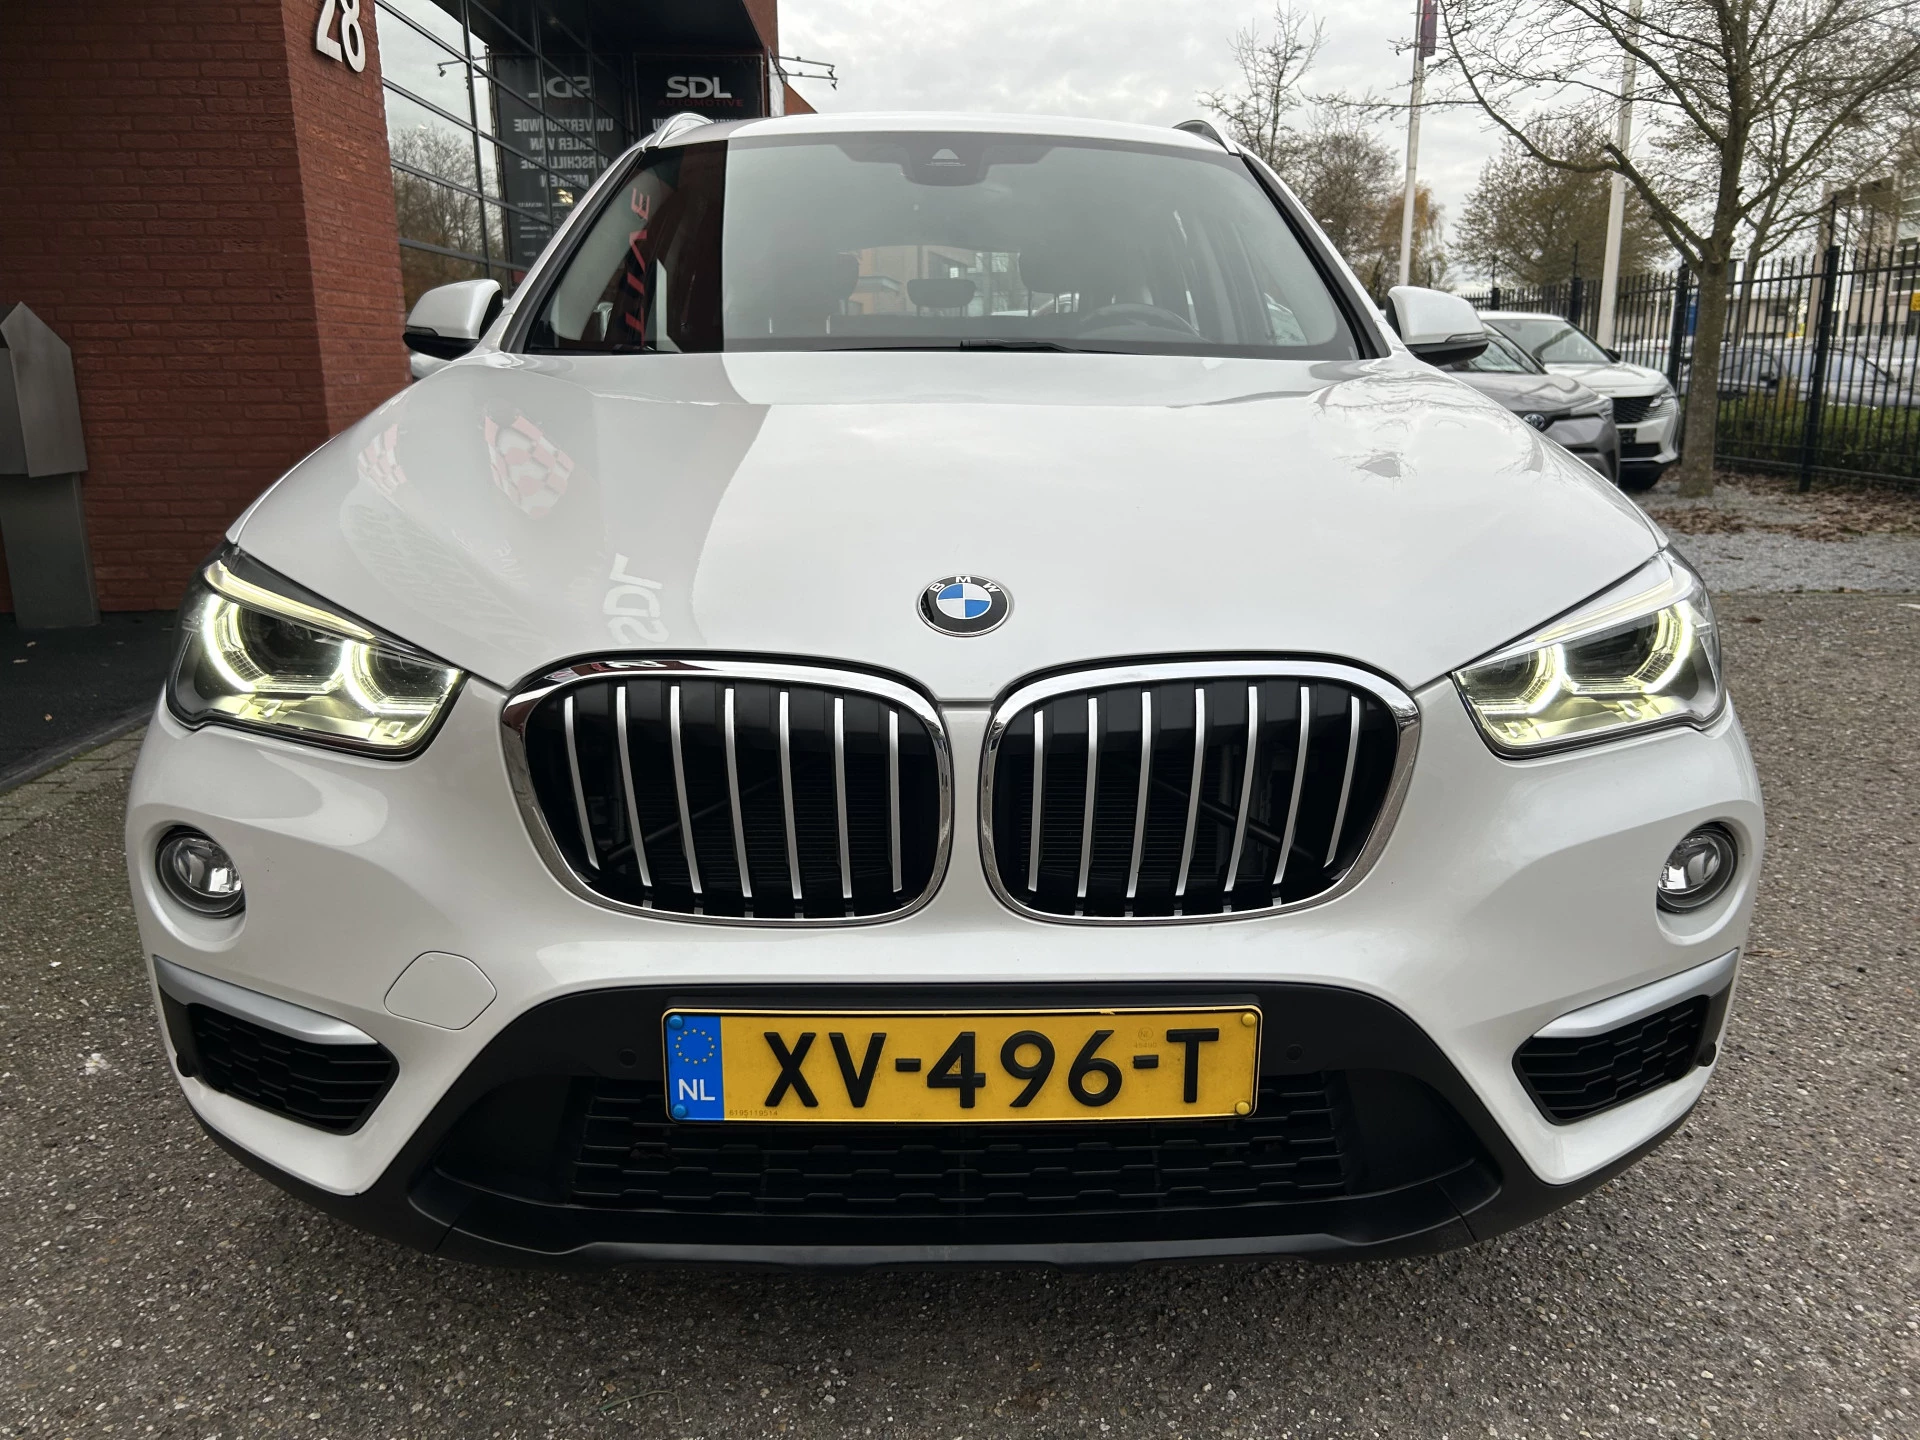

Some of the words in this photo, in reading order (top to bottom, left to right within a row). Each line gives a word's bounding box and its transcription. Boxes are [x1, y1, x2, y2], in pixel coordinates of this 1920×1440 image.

[316, 0, 366, 73] 28
[666, 76, 732, 99] SDL
[658, 99, 744, 108] AUTOMOTIVE
[929, 576, 1001, 593] BMW
[763, 1027, 1220, 1109] XV-496-T
[678, 1078, 716, 1101] NL
